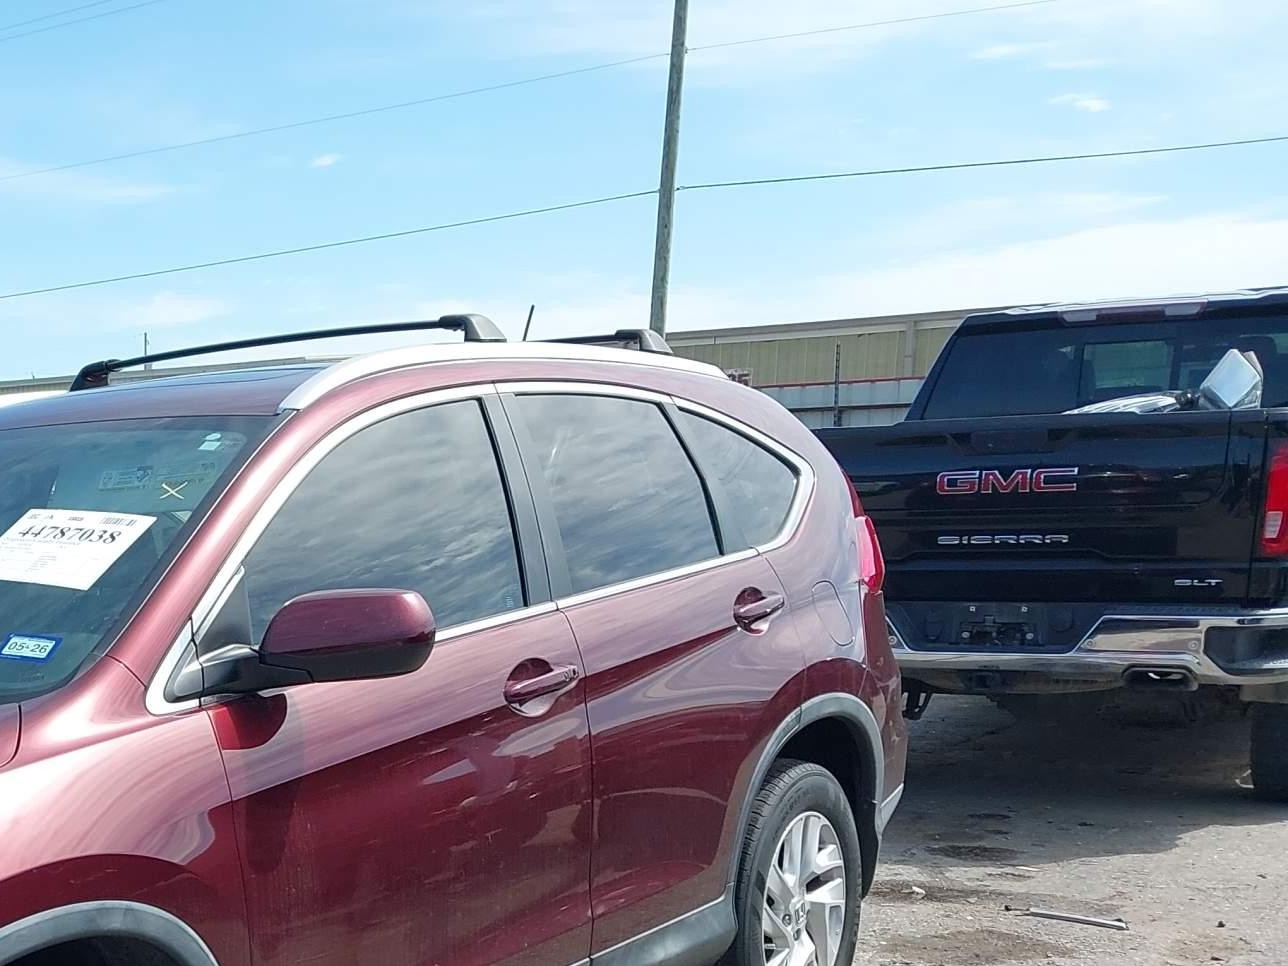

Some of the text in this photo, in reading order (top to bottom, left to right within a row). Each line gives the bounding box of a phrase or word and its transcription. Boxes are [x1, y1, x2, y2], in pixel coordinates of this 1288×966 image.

[936, 466, 1079, 495] GMC
[18, 524, 122, 545] 44787038
[937, 534, 1070, 545] SIERRA
[1173, 579, 1224, 587] SLT
[7, 641, 50, 654] 05 26
